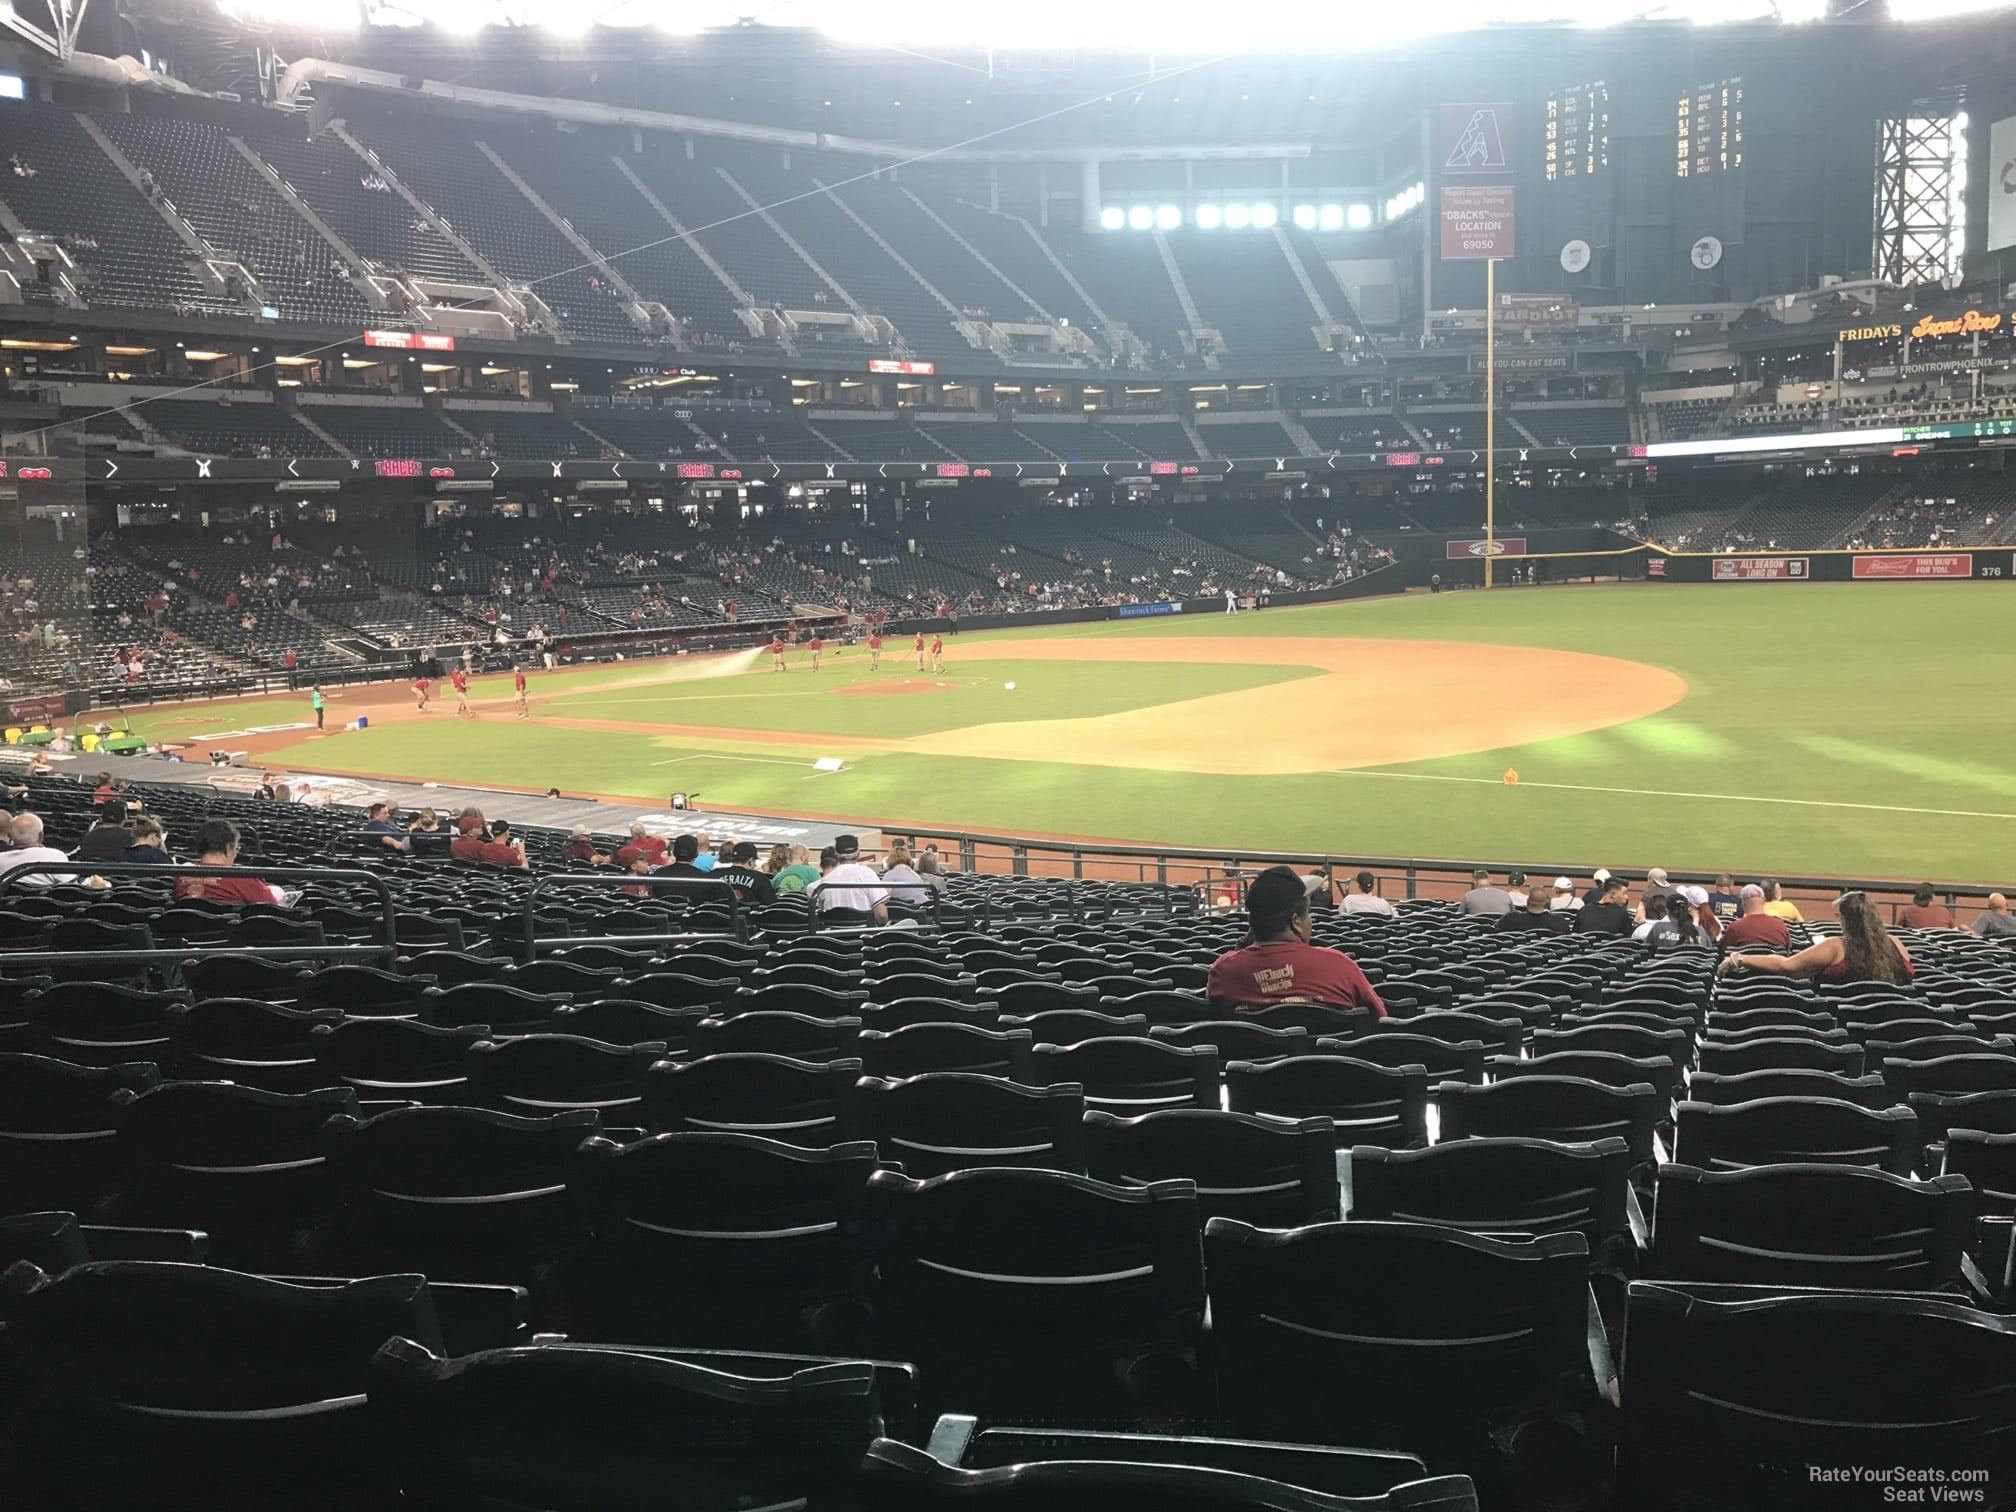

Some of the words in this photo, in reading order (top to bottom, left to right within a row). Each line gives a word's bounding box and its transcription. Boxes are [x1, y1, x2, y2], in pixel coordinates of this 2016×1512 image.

[1455, 221, 1502, 231] LOCATION
[1463, 240, 1494, 250] 69050
[1839, 324, 1902, 342] FRIDAY'S
[1962, 310, 2001, 332] Row
[1544, 358, 1566, 367] SEATS
[1900, 357, 2009, 374] FRONTROWPHOENIX.com
[1755, 560, 1784, 569] SEASON
[1981, 567, 2001, 576] 376
